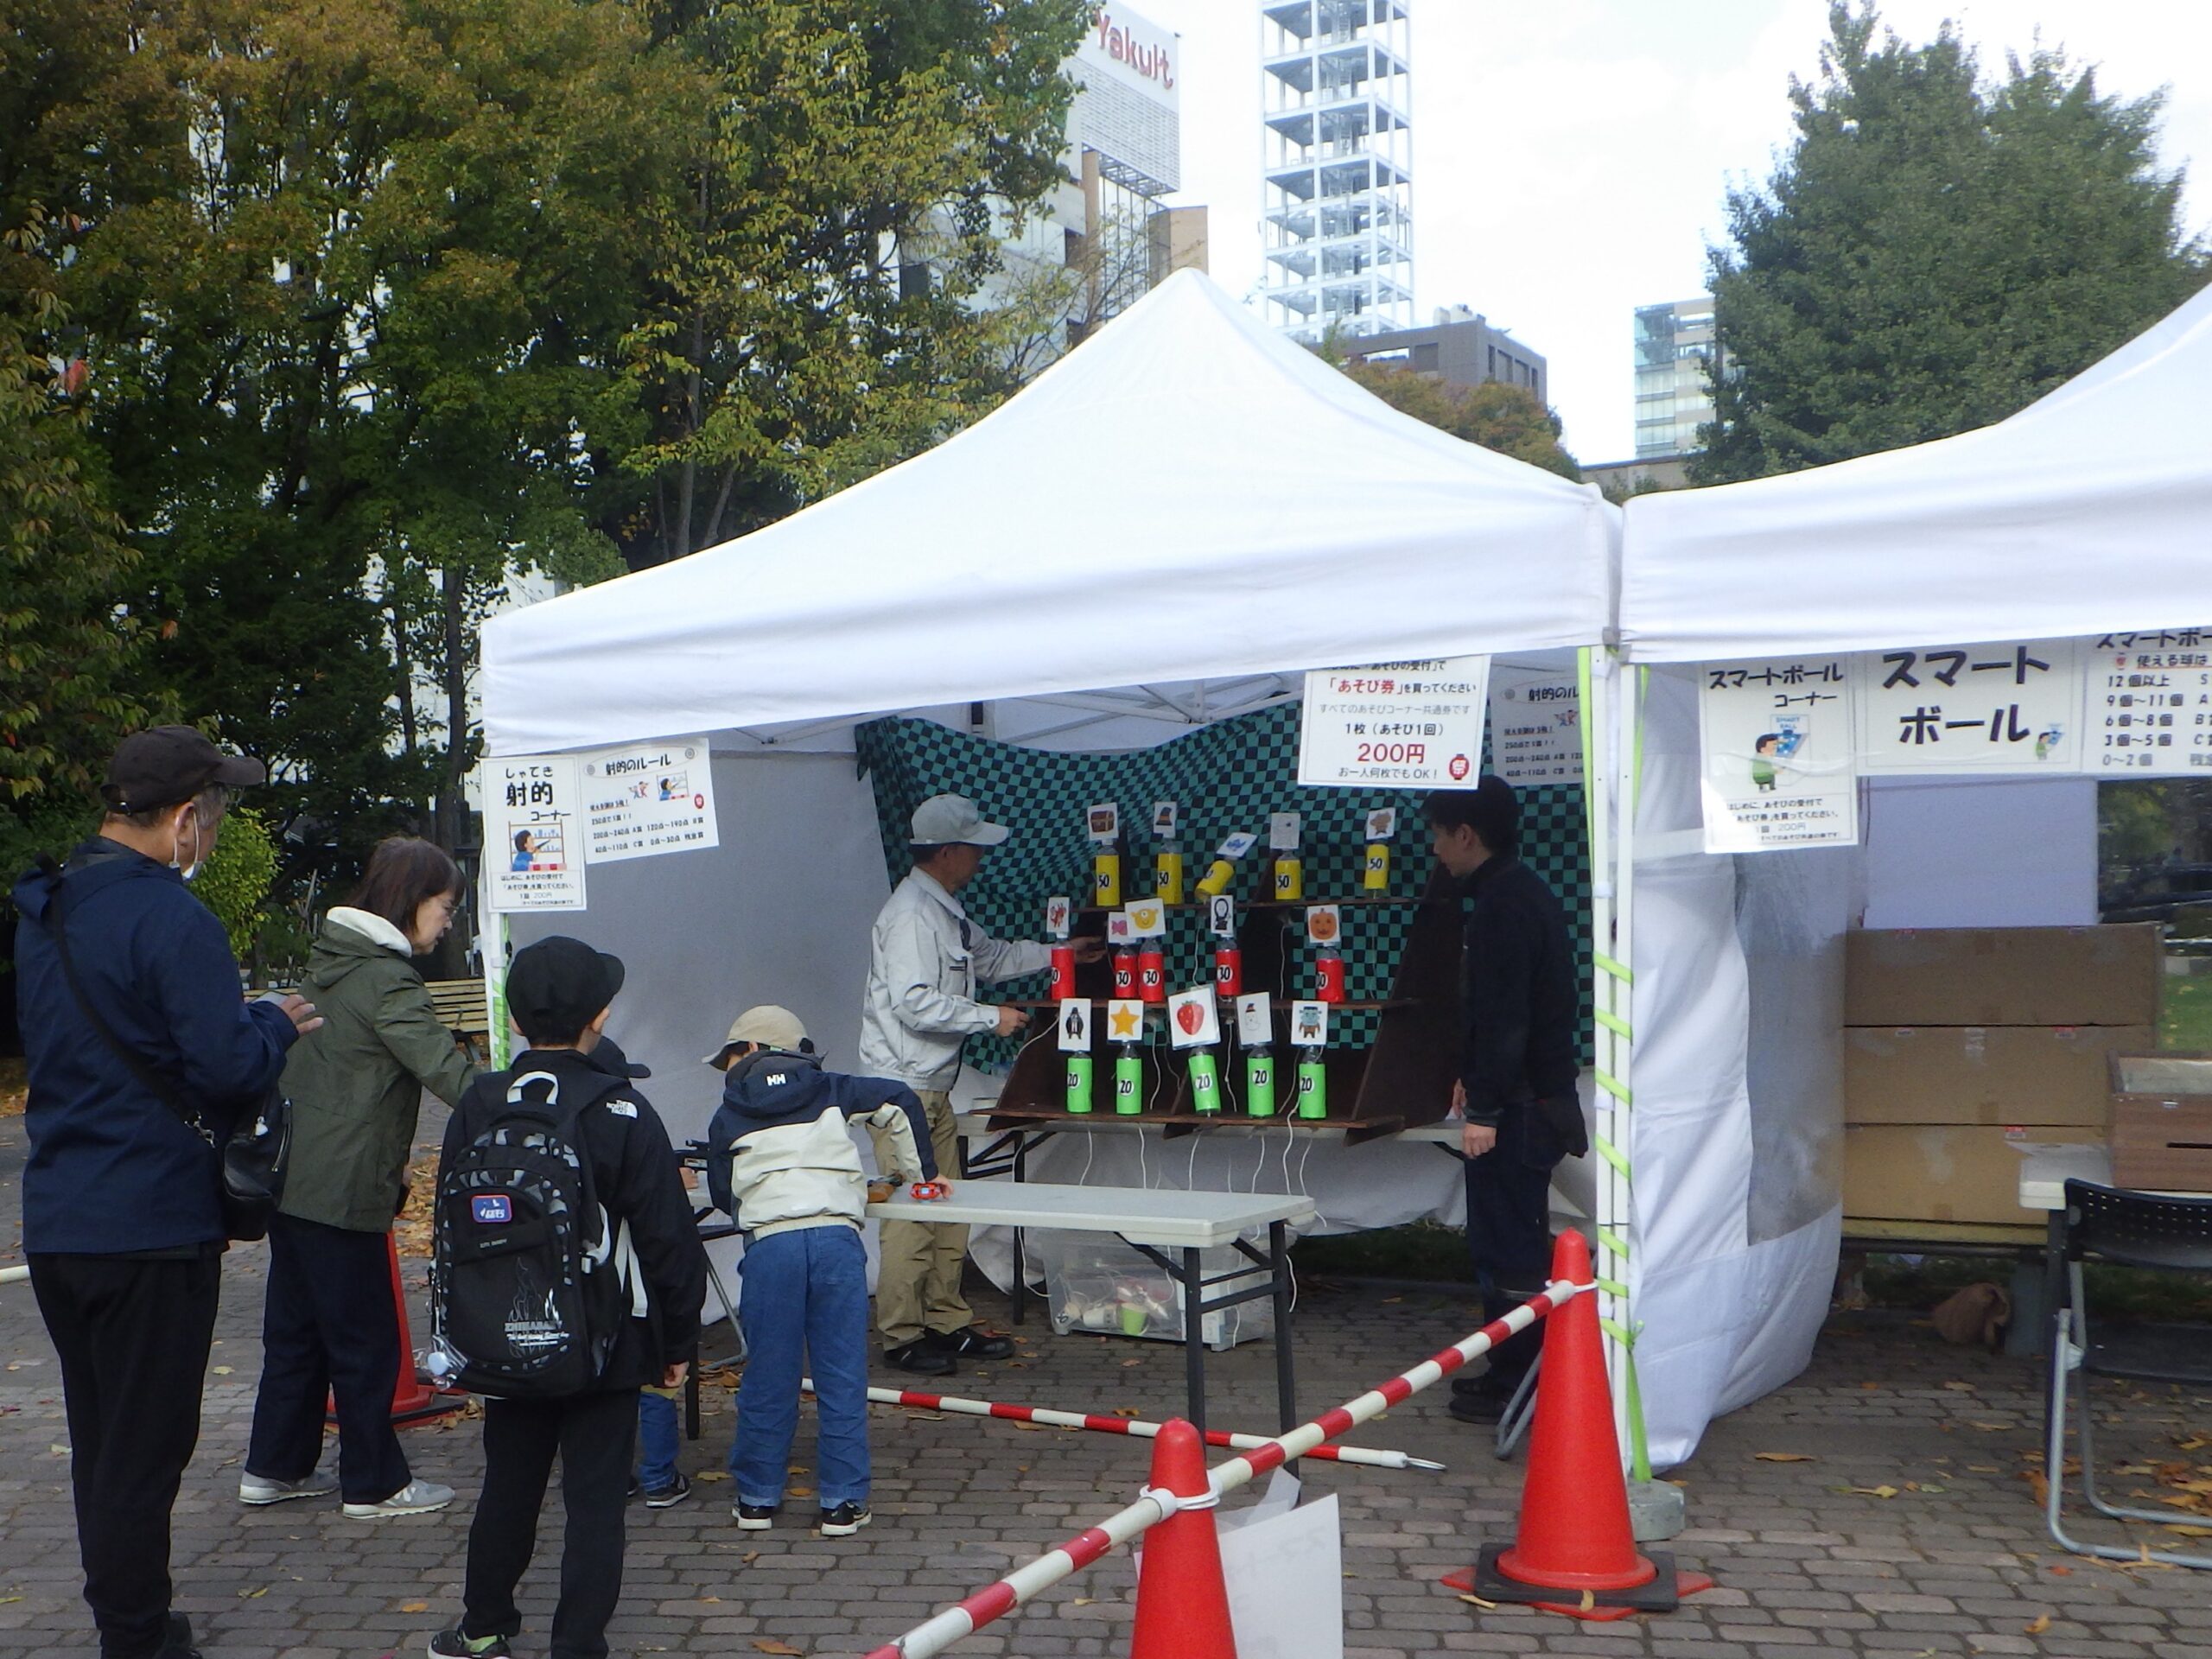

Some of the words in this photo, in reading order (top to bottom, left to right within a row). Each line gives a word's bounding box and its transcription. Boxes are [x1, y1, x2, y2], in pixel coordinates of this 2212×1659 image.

[1094, 6, 1173, 90] Yakult
[1883, 645, 2050, 689] スマート
[1709, 663, 1844, 690] スマートボール
[1329, 677, 1477, 695] 「あそび券」を買ってください
[1775, 691, 1838, 708] コーナー
[1899, 703, 2031, 745] ボール
[1357, 742, 1425, 764] 200円
[606, 753, 671, 776] 射的のルール
[505, 766, 554, 779] しゃてき
[505, 781, 554, 807] 射的
[531, 810, 571, 822] コーナー
[1368, 857, 1384, 869] 50
[1098, 874, 1110, 888] 50
[1118, 971, 1130, 986] 30
[1144, 970, 1158, 984] 30
[1220, 966, 1231, 981] 30
[1198, 1074, 1211, 1090] 20
[1255, 1070, 1268, 1084] 20
[1301, 1077, 1313, 1091] 20
[1121, 1080, 1132, 1094] 20
